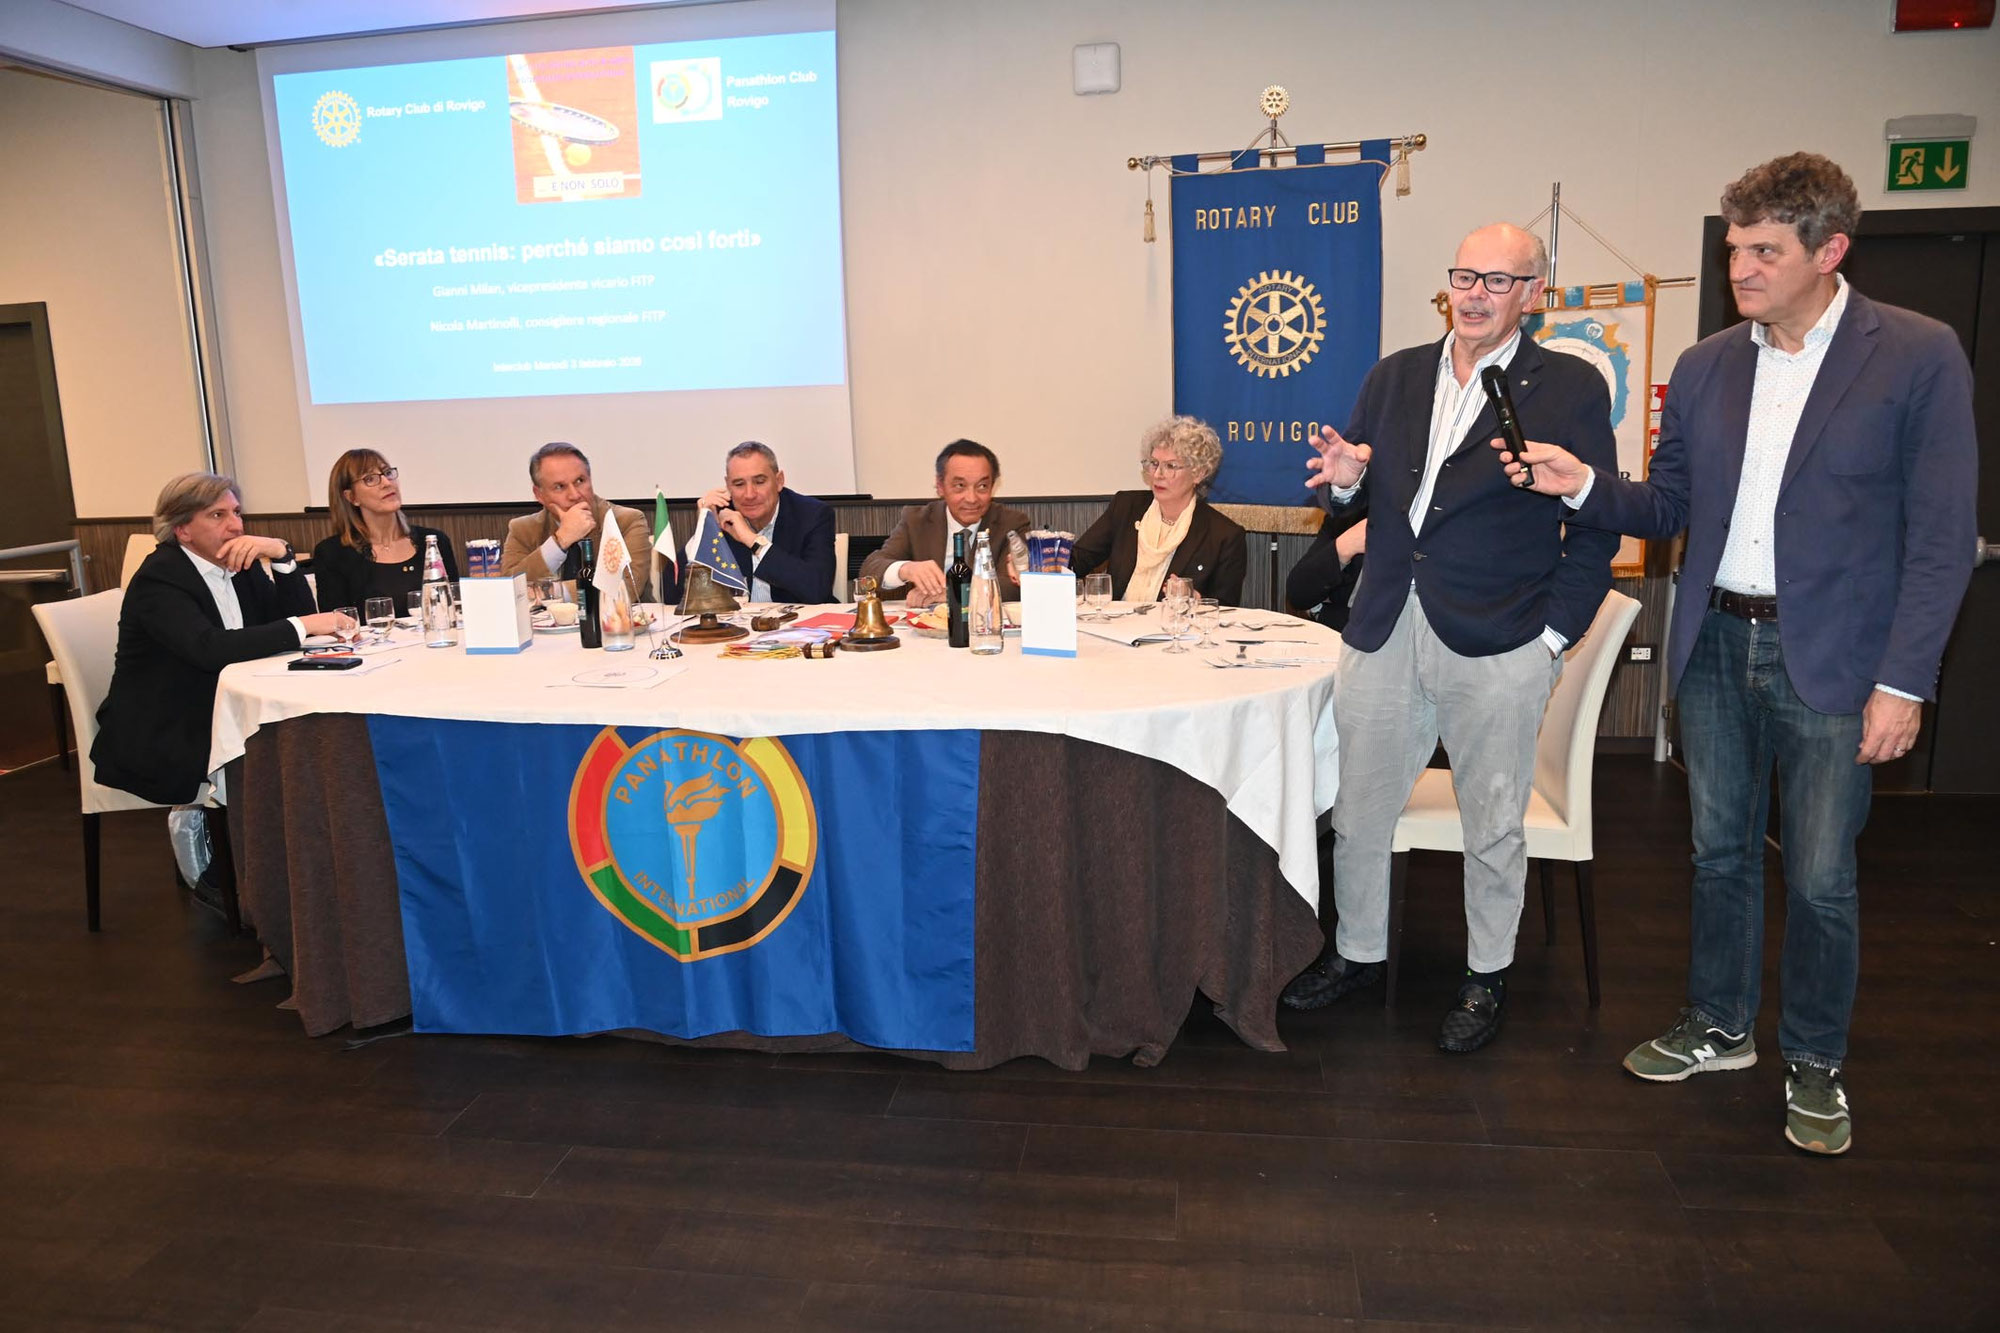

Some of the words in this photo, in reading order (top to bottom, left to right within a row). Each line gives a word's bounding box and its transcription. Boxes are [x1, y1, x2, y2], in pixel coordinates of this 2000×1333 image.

[726, 74, 786, 87] Panathlon
[789, 71, 817, 83] Club
[367, 105, 402, 118] Rotary
[405, 103, 431, 115] Club
[433, 101, 444, 113] di
[446, 99, 486, 112] Rovigo
[727, 96, 769, 109] Rovigo
[560, 180, 586, 191] NON
[591, 178, 619, 189] SOLO
[1195, 205, 1276, 230] ROTARY
[1308, 201, 1359, 225] CLUB
[375, 247, 445, 267] «Serata
[450, 243, 515, 264] tennis:
[520, 237, 589, 264] perché
[594, 235, 655, 256] siamo
[708, 227, 761, 250] forti»
[433, 284, 468, 296] Gianni
[591, 276, 629, 289] vicario
[1259, 283, 1294, 294] ROTARY
[430, 319, 464, 332] Nicola
[1246, 346, 1304, 365] INTERNATIONAL
[1228, 421, 1319, 442] ROVIGO
[614, 742, 758, 804] PANATHLON
[633, 870, 755, 916] INTERNATIONAL
